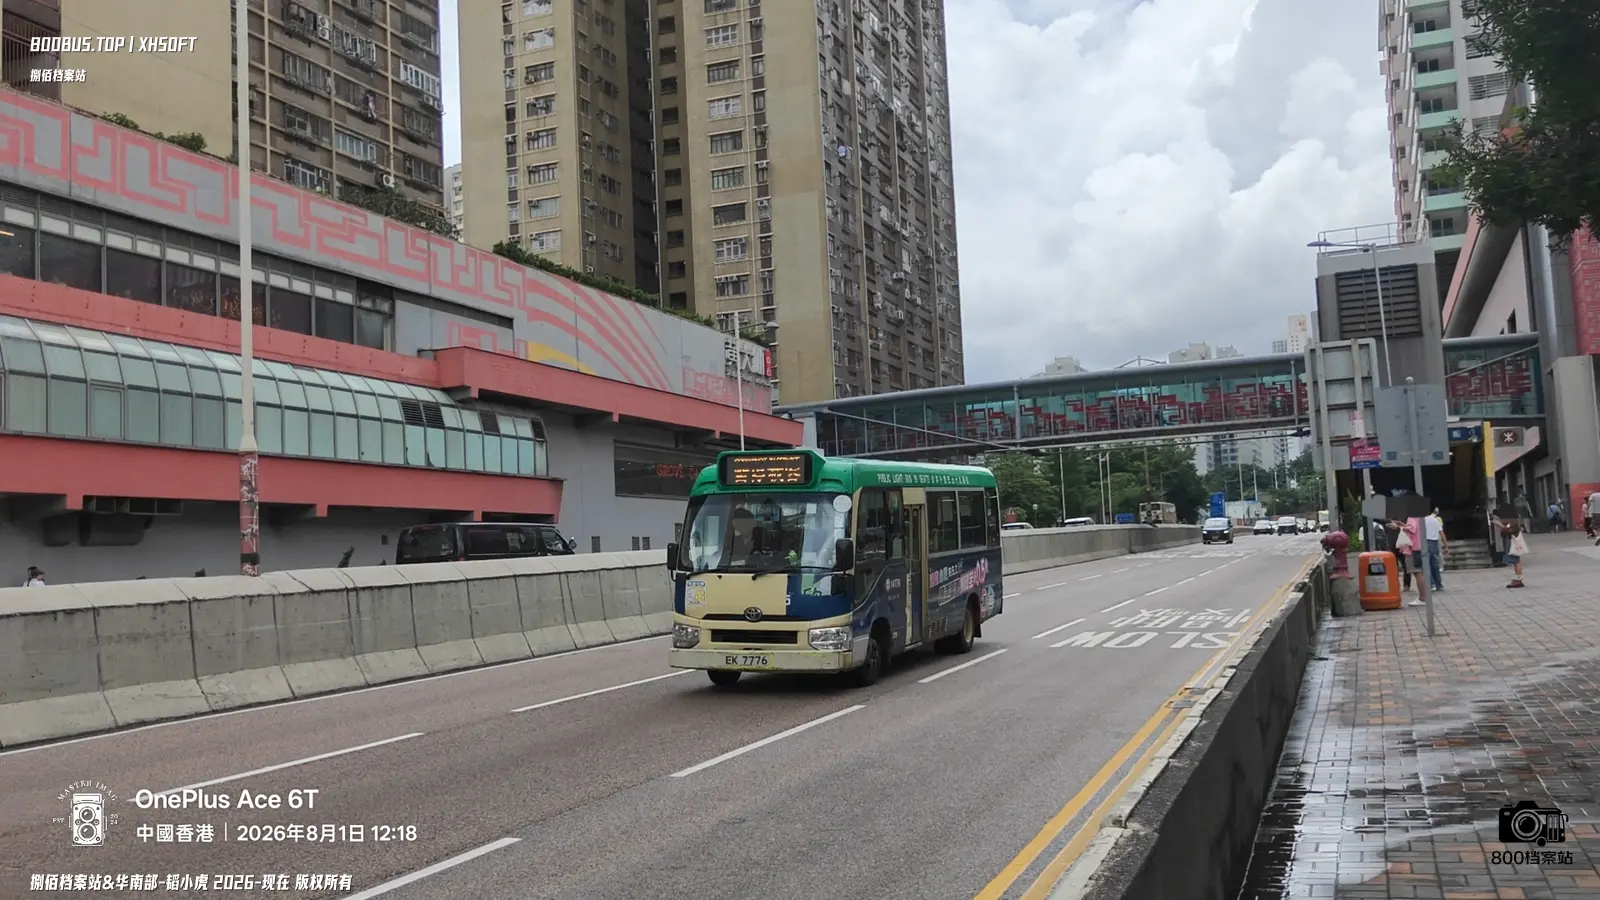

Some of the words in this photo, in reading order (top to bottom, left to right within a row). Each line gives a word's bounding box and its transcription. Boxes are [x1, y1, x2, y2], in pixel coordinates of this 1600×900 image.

[1048, 631, 1239, 649] SLOW
[725, 656, 738, 665] EK
[742, 656, 768, 665] 7776
